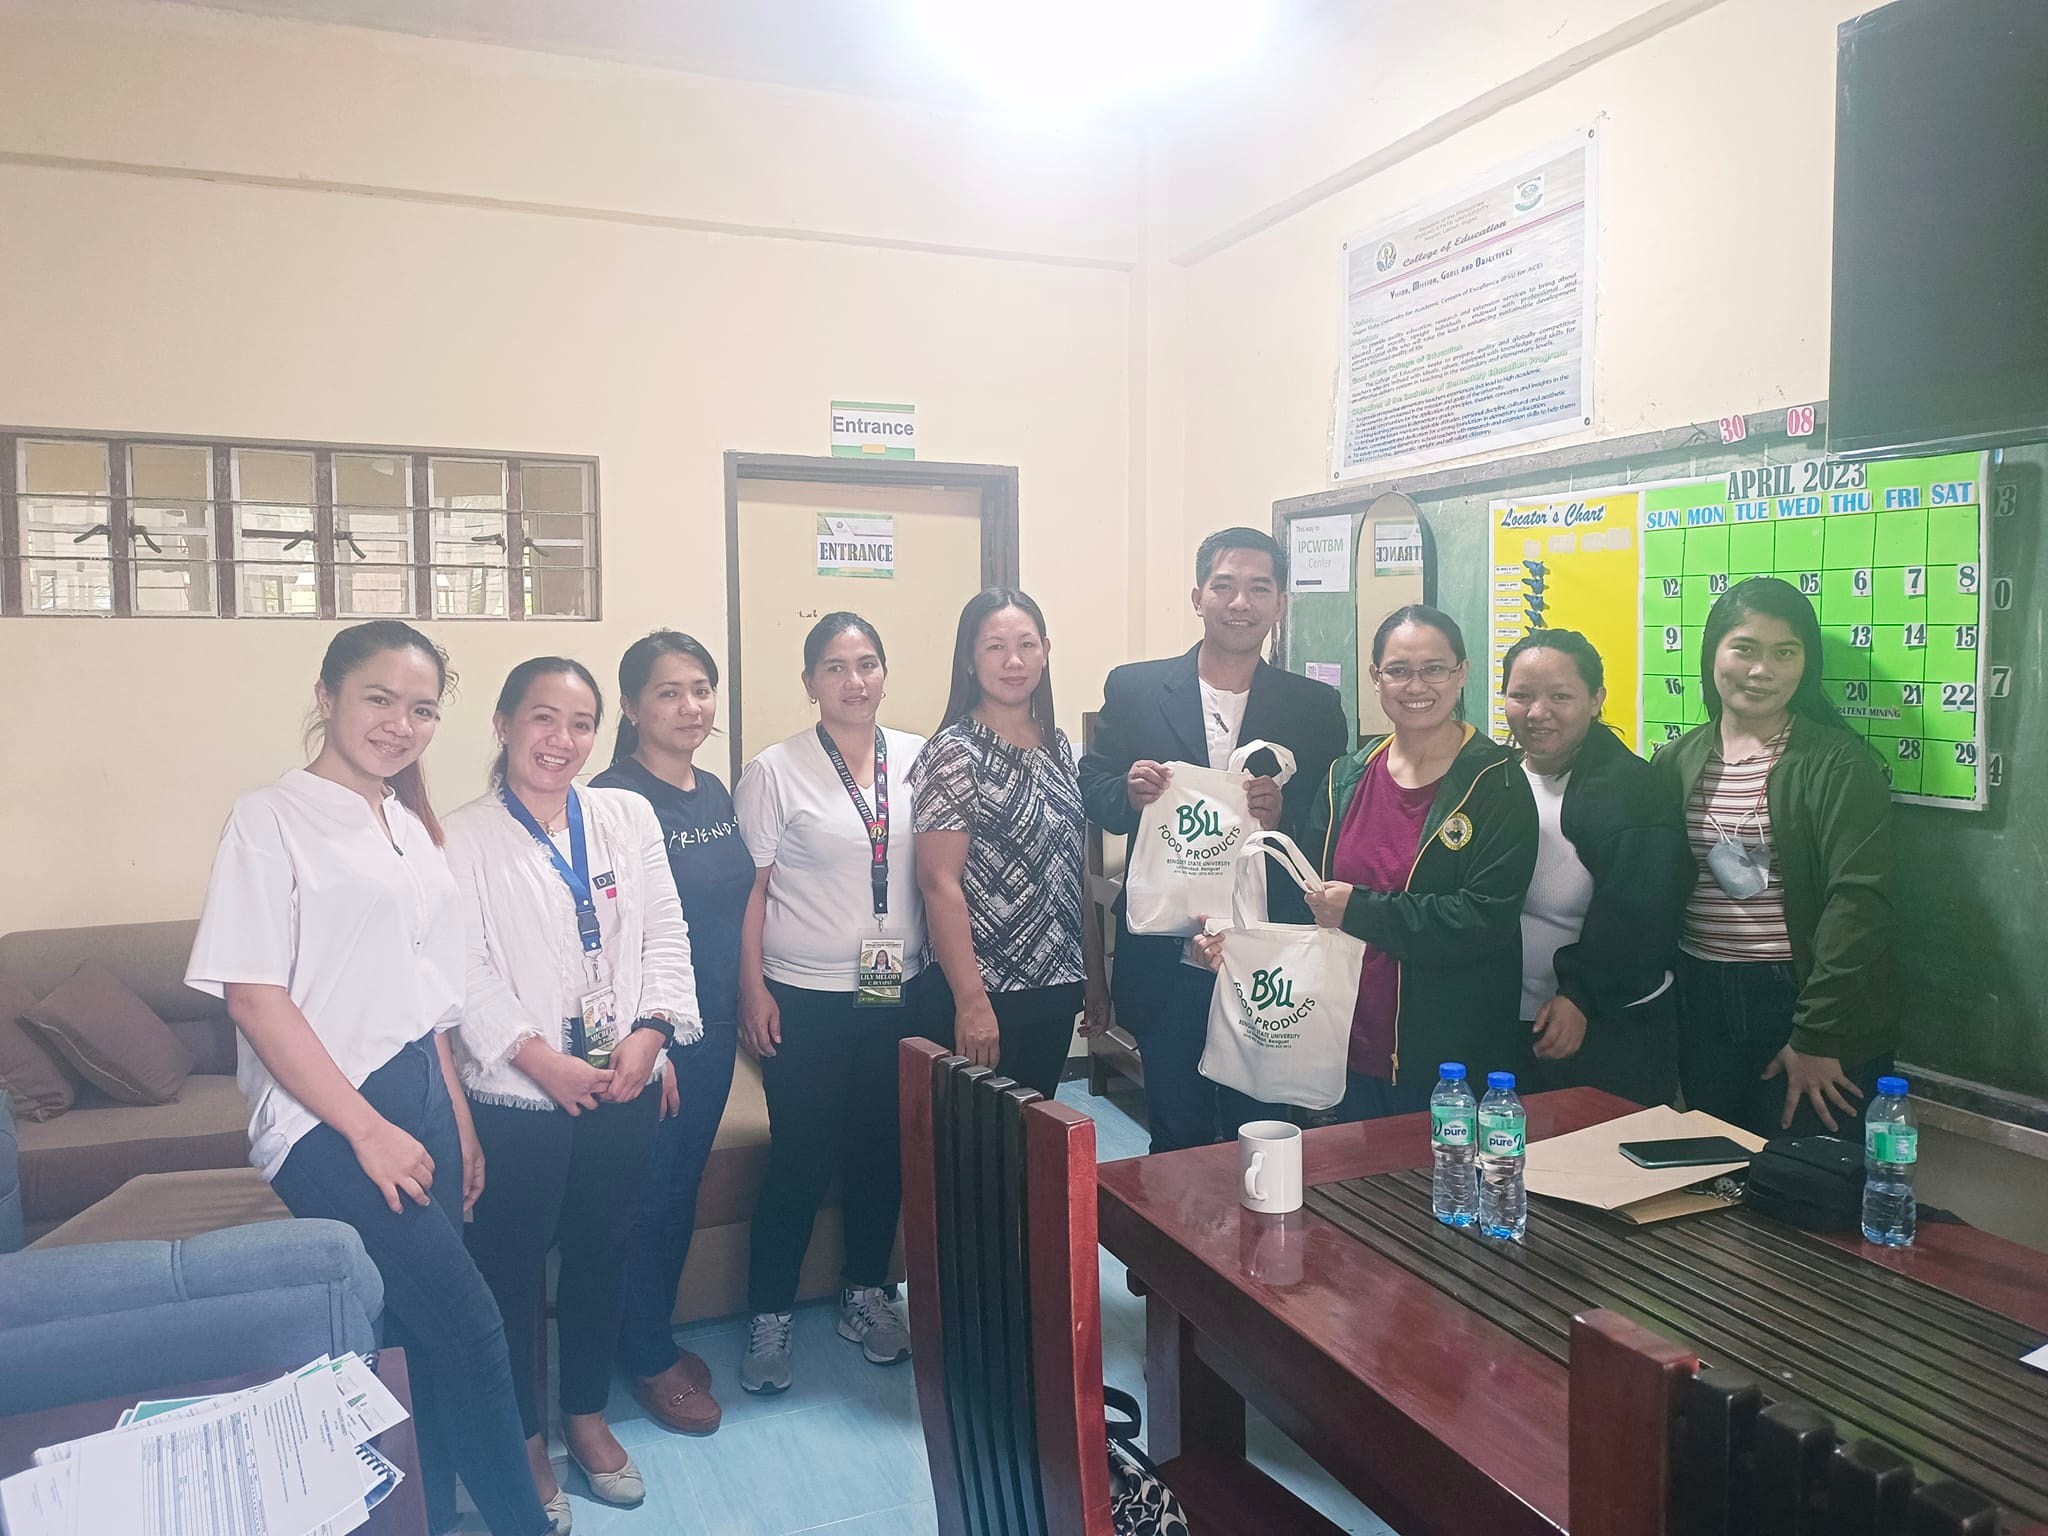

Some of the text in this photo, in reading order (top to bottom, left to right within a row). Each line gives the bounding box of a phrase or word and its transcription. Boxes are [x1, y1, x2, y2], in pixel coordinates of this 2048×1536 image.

[1402, 249, 1437, 266] College
[1440, 240, 1451, 251] of
[1454, 221, 1506, 245] Education
[1469, 280, 1498, 292] Excellence
[1557, 272, 1576, 282] about
[832, 416, 914, 436] Entrance
[1720, 414, 1745, 442] 30
[1788, 407, 1813, 434] 08
[1728, 461, 1865, 500] APRIL 2023
[1501, 503, 1605, 527] Locator's Chart
[1647, 482, 1973, 529] SUN MON TUE WED THU FRI SAT
[819, 542, 893, 562] ENTRANCE
[1298, 538, 1344, 554] IPCWTBM
[1308, 557, 1331, 569] Center
[1663, 566, 1976, 596] 02 03 05 6 7 8
[1666, 624, 1976, 647] 9 13 14 15
[1665, 678, 1974, 706] 16 20 21 22
[1992, 668, 2010, 695] 7
[1870, 708, 1900, 717] MINING
[1899, 739, 1920, 759] 28
[1955, 743, 1977, 764] 29
[1176, 799, 1223, 843] BSU
[1158, 824, 1241, 860] FOOD PRODUCTS
[1251, 966, 1295, 1011] BSU
[1233, 982, 1316, 1031] FOOD PRODUCTS
[1444, 1127, 1467, 1136] pure
[1489, 1137, 1513, 1147] pure
